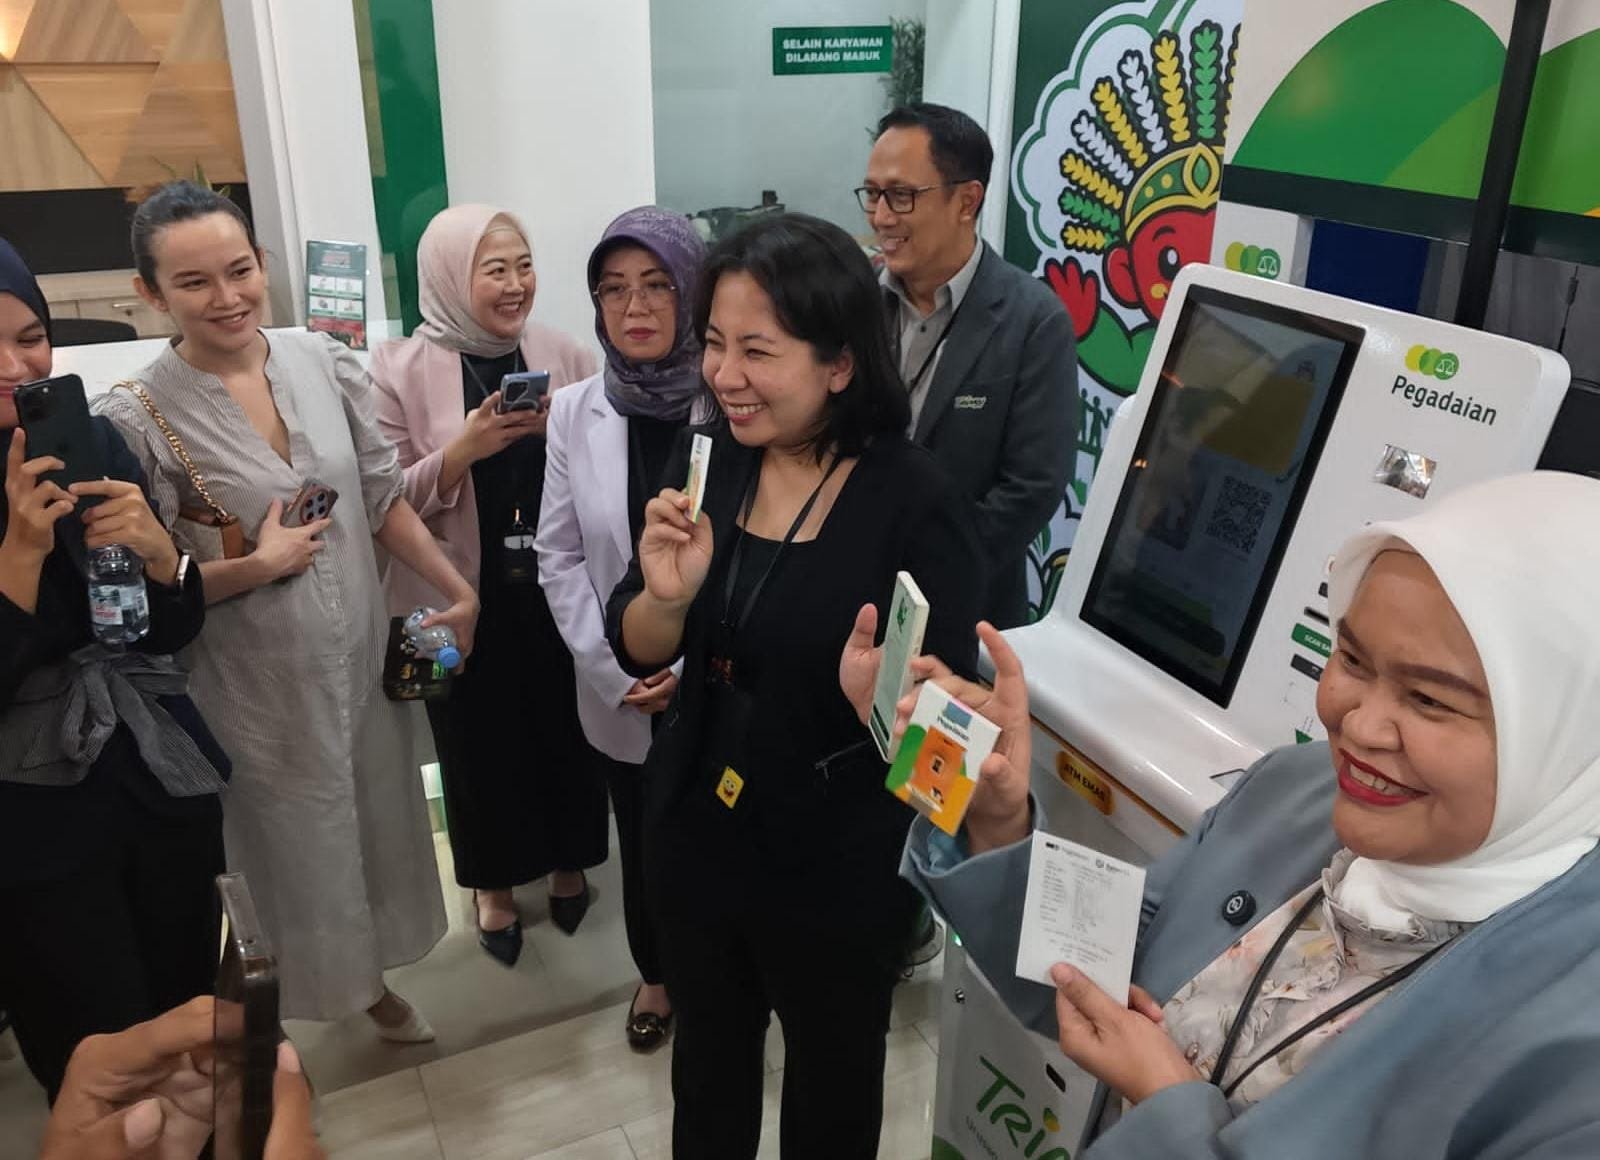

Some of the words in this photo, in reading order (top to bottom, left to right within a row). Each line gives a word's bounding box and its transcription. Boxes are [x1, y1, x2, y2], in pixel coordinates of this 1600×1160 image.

[783, 38, 822, 49] SELAIN
[824, 37, 883, 48] KARYAWAN
[785, 52, 841, 63] DILARANG
[842, 51, 881, 61] MASUK
[1391, 375, 1497, 426] Pegadaian
